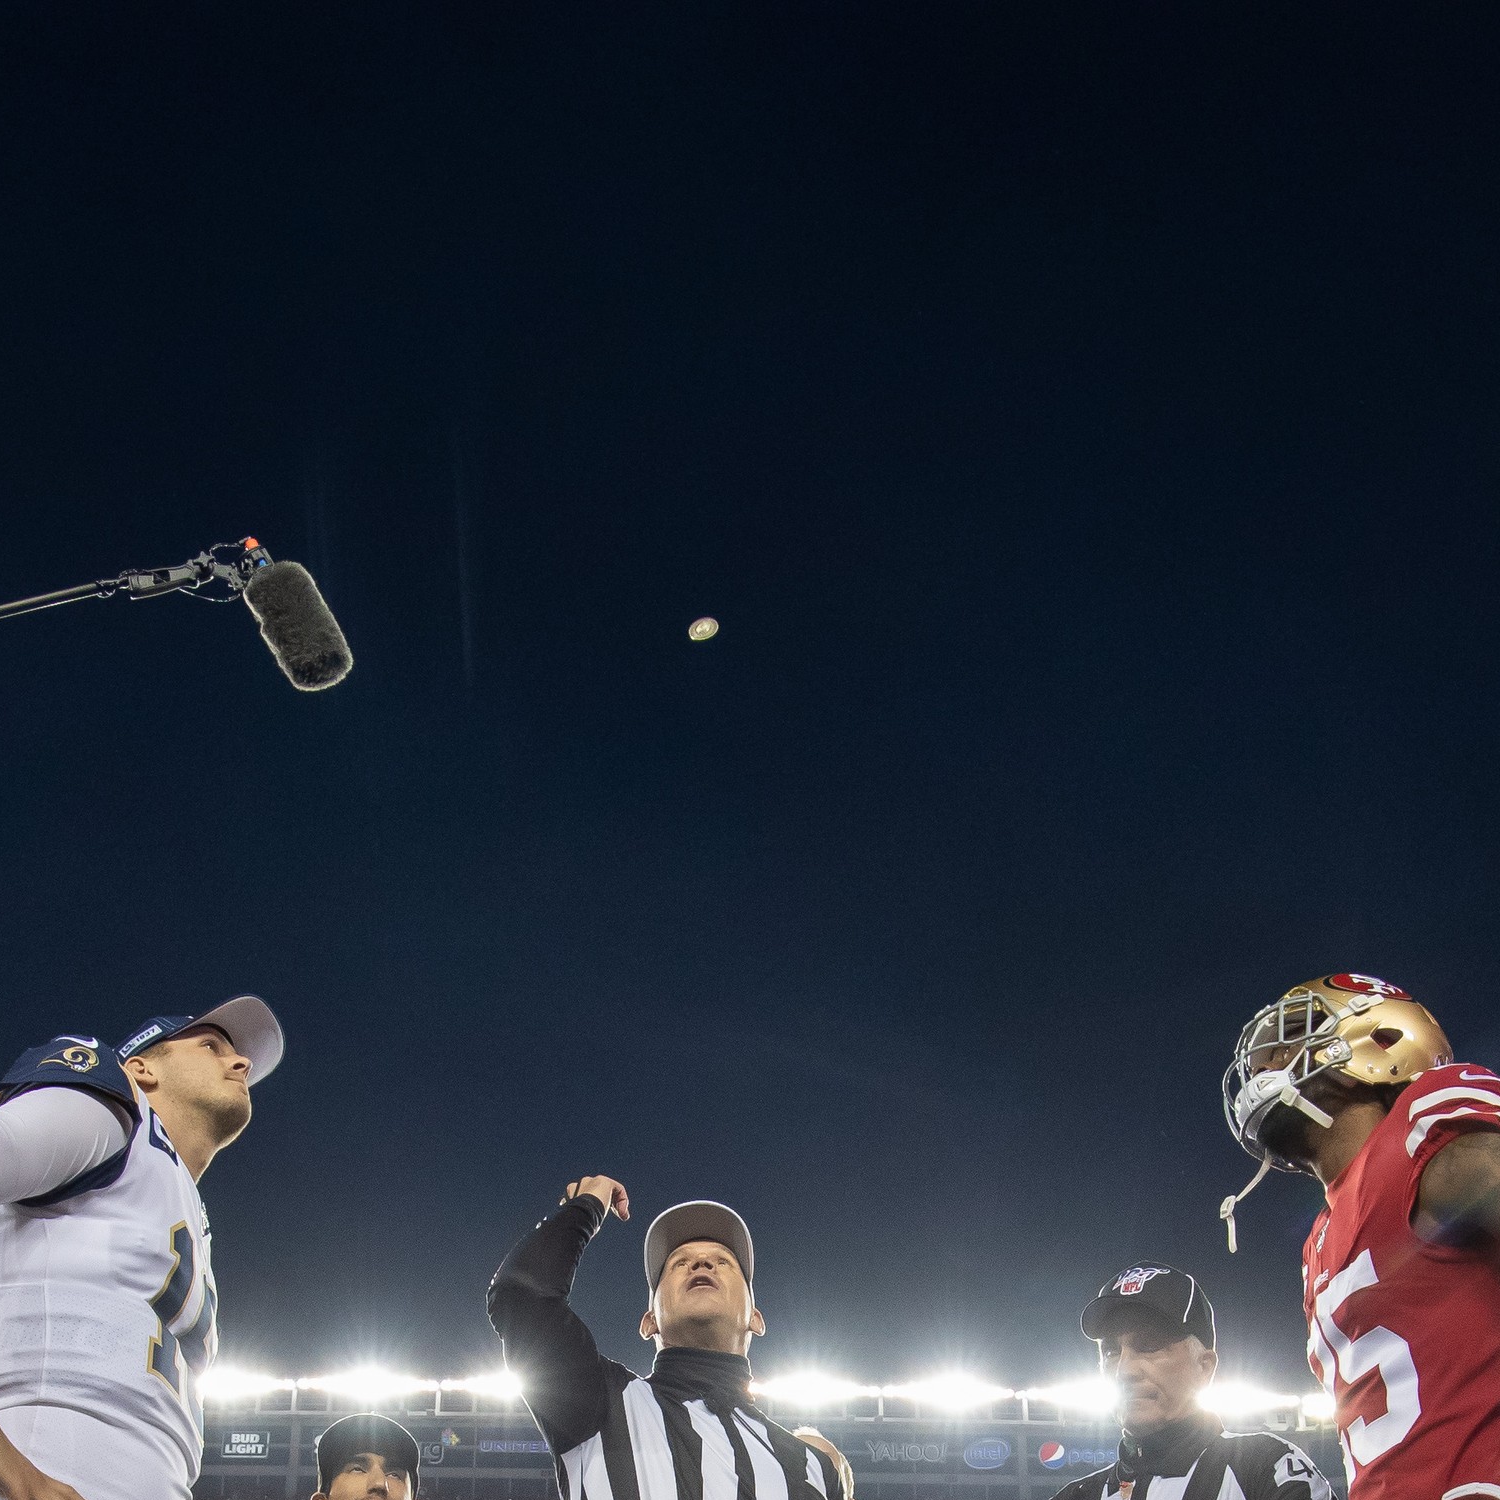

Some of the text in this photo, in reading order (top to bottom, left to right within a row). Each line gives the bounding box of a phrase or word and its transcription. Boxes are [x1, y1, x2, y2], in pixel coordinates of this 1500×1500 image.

[230, 1434, 260, 1444] BUD
[224, 1443, 265, 1455] LIGHT
[866, 1440, 947, 1462] YAHOO!
